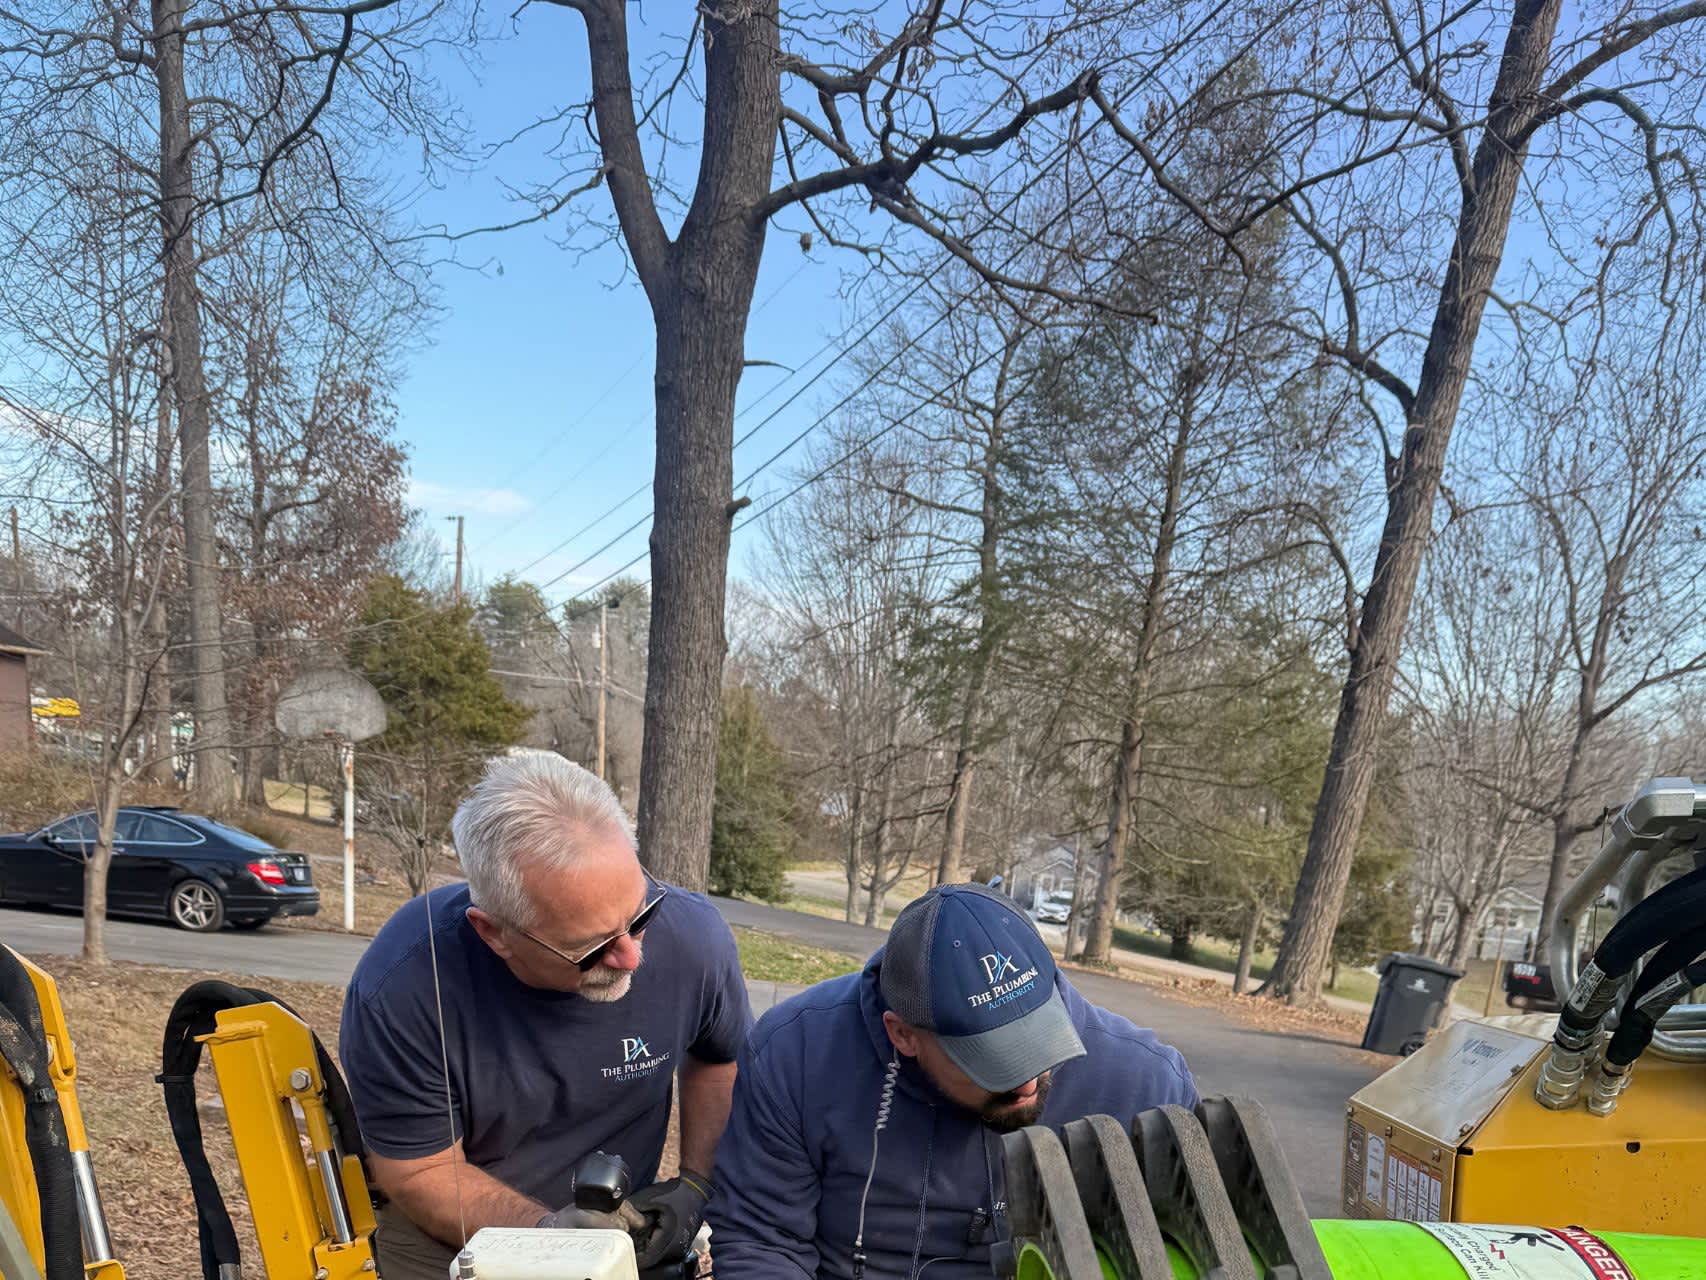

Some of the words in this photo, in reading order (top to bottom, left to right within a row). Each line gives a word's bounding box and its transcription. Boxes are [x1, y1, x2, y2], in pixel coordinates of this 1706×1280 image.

[979, 951, 1020, 985] PA
[968, 992, 993, 1007] THE
[992, 966, 1039, 998] PLUMBIN
[988, 980, 1036, 1011] AUTHORITY
[621, 1036, 652, 1062] PA
[600, 1067, 622, 1078] THE
